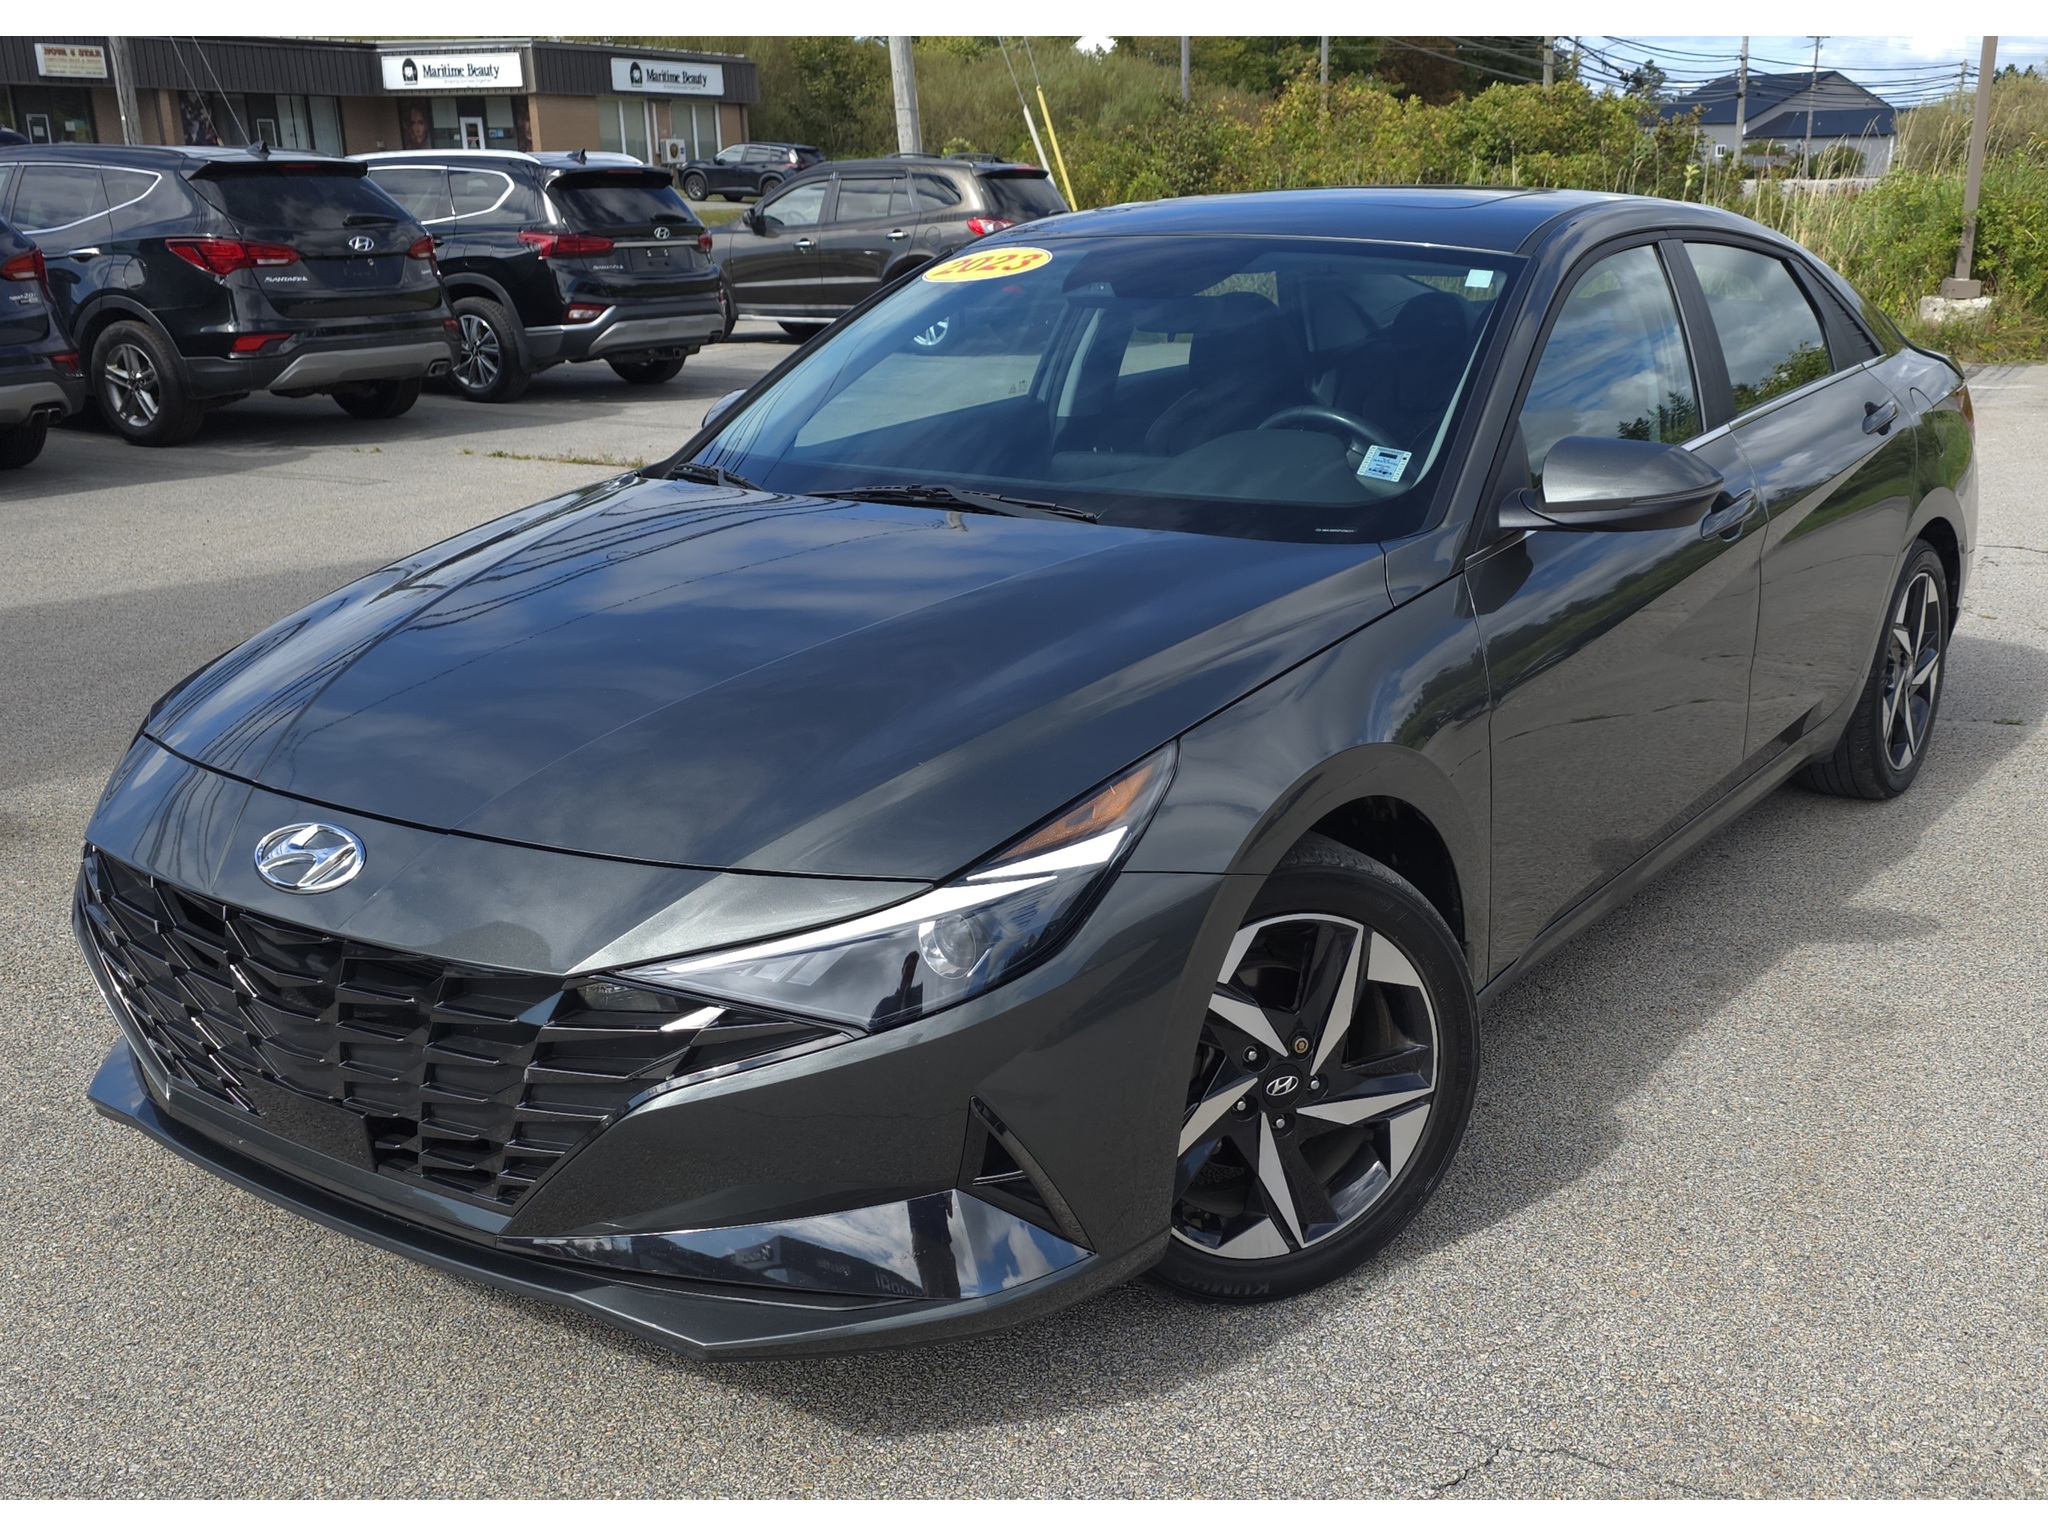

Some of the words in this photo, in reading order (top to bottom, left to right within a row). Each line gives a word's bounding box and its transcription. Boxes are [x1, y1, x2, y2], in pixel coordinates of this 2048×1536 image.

[422, 64, 465, 79] Maritime
[467, 63, 500, 79] Beauty
[646, 68, 680, 84] Maritime
[682, 70, 707, 87] Beauty
[932, 253, 1043, 277] 2023
[1176, 1270, 1270, 1295] KUMHO
